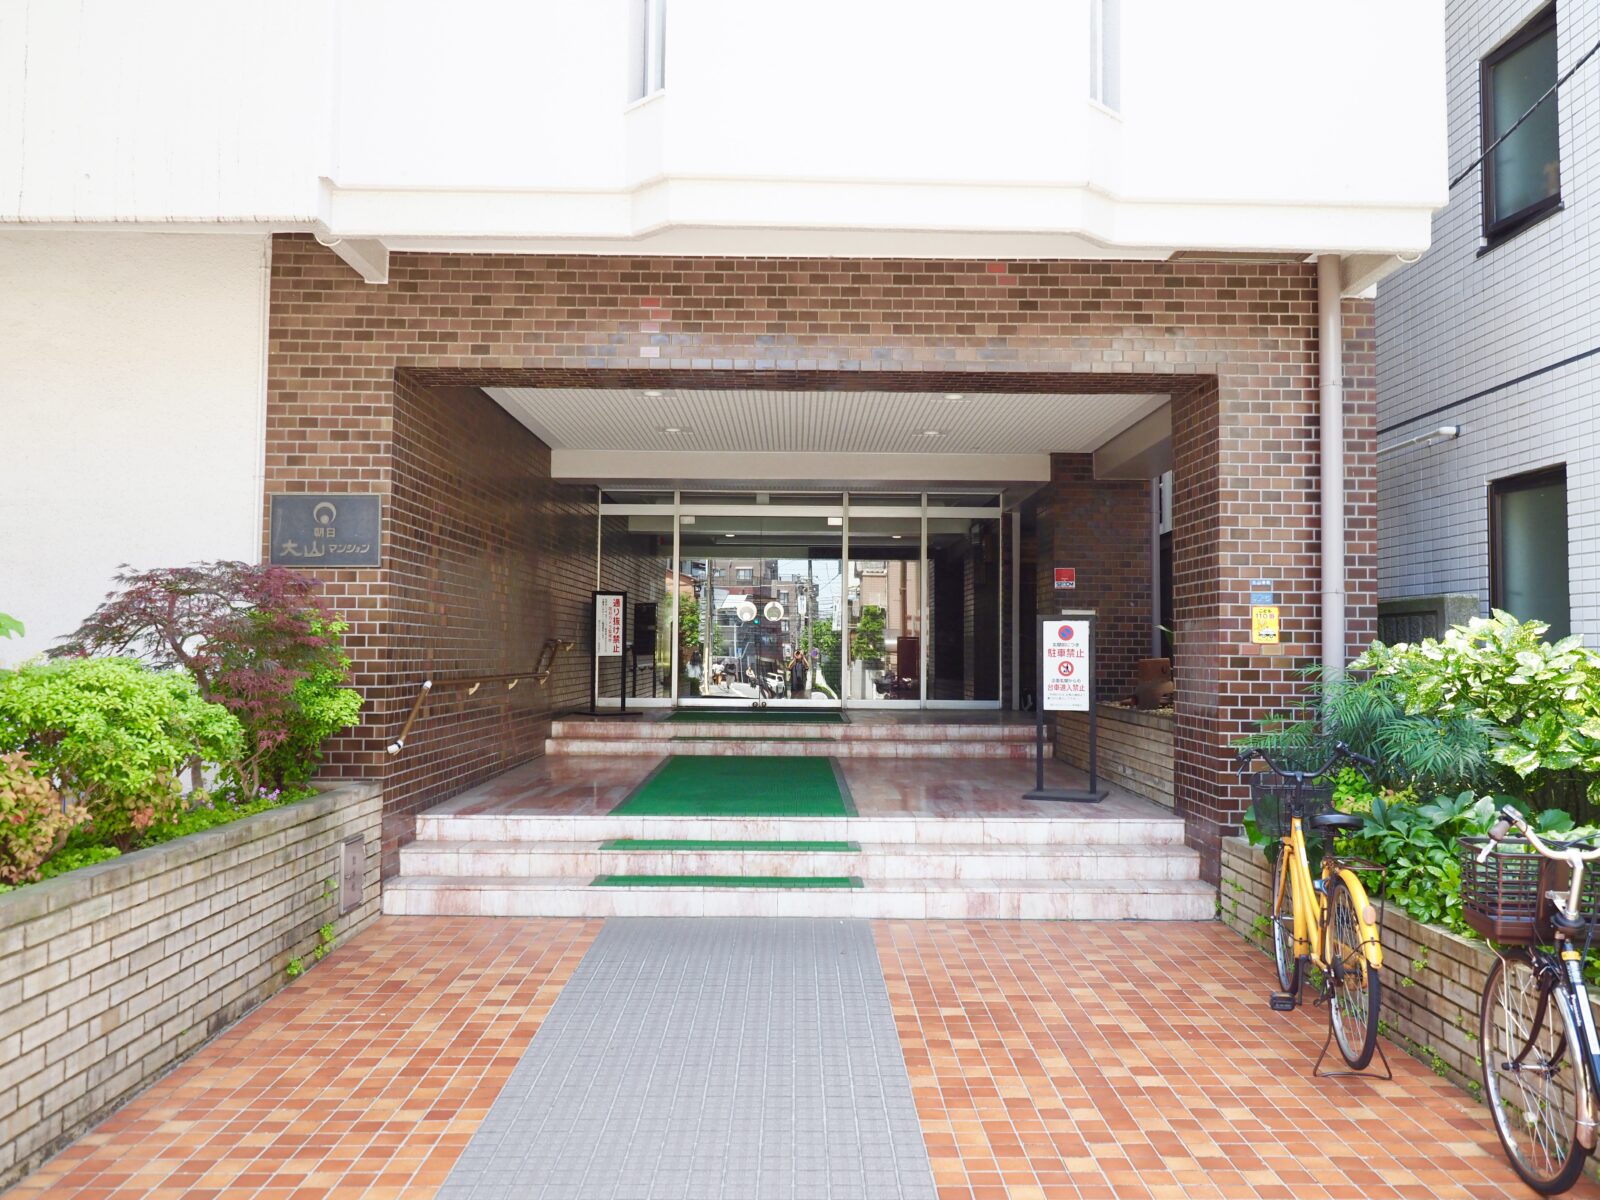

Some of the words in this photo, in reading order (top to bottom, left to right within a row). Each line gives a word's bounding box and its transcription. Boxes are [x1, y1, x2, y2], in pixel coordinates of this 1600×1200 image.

[280, 540, 370, 558] 大山マンション
[613, 598, 621, 653] 通り抜け禁止
[1047, 648, 1085, 658] 駐車禁止
[1047, 684, 1085, 692] 台車進入禁止
